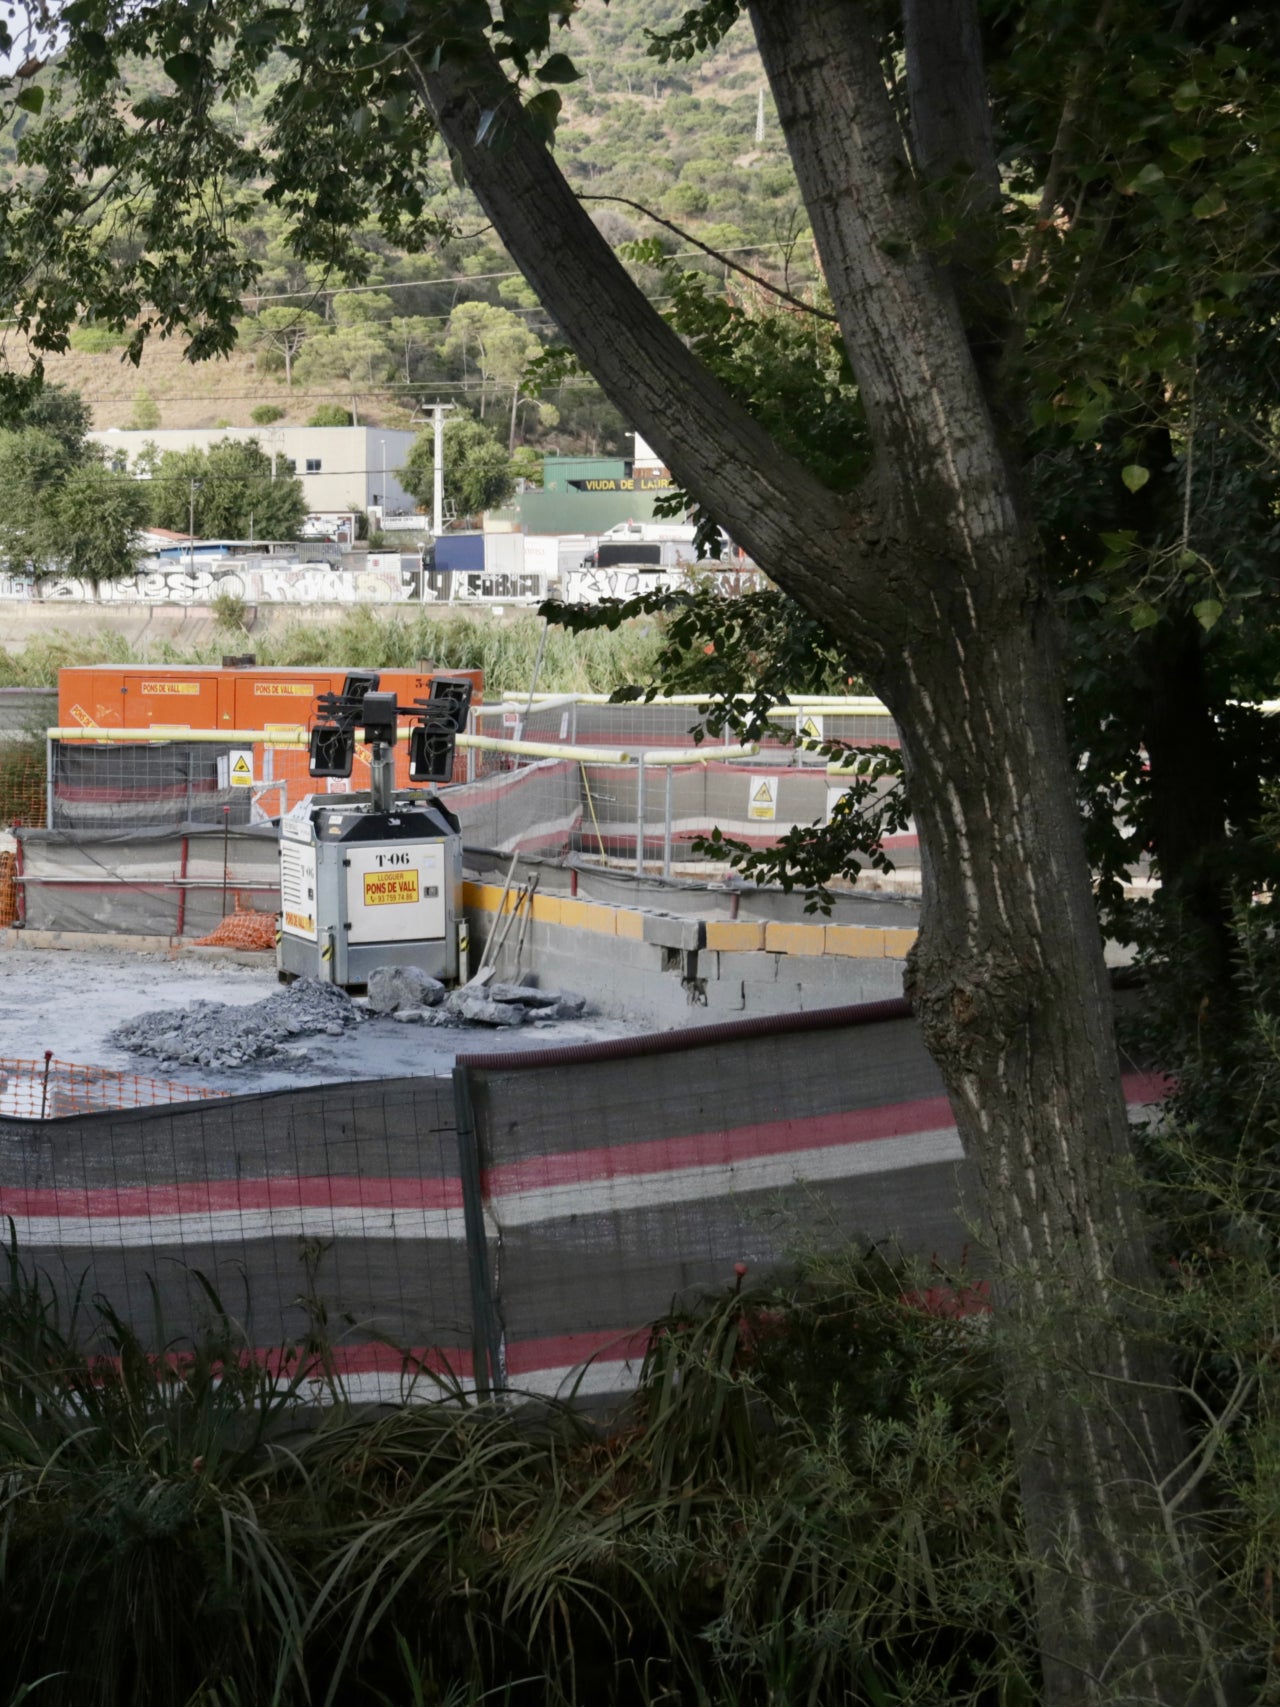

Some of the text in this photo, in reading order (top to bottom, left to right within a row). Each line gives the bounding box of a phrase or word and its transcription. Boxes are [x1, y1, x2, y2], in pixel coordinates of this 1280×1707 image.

[586, 480, 615, 490] VIUDA
[620, 480, 634, 489] DE
[143, 684, 158, 692] PONS
[158, 684, 166, 692] DE
[166, 684, 180, 692] VALL
[255, 685, 271, 694] PONS
[272, 686, 280, 694] DE
[280, 686, 294, 694] VALL
[376, 852, 410, 867] T-06
[378, 873, 404, 881] LLOGUER
[366, 881, 416, 895] PONS DE VALL
